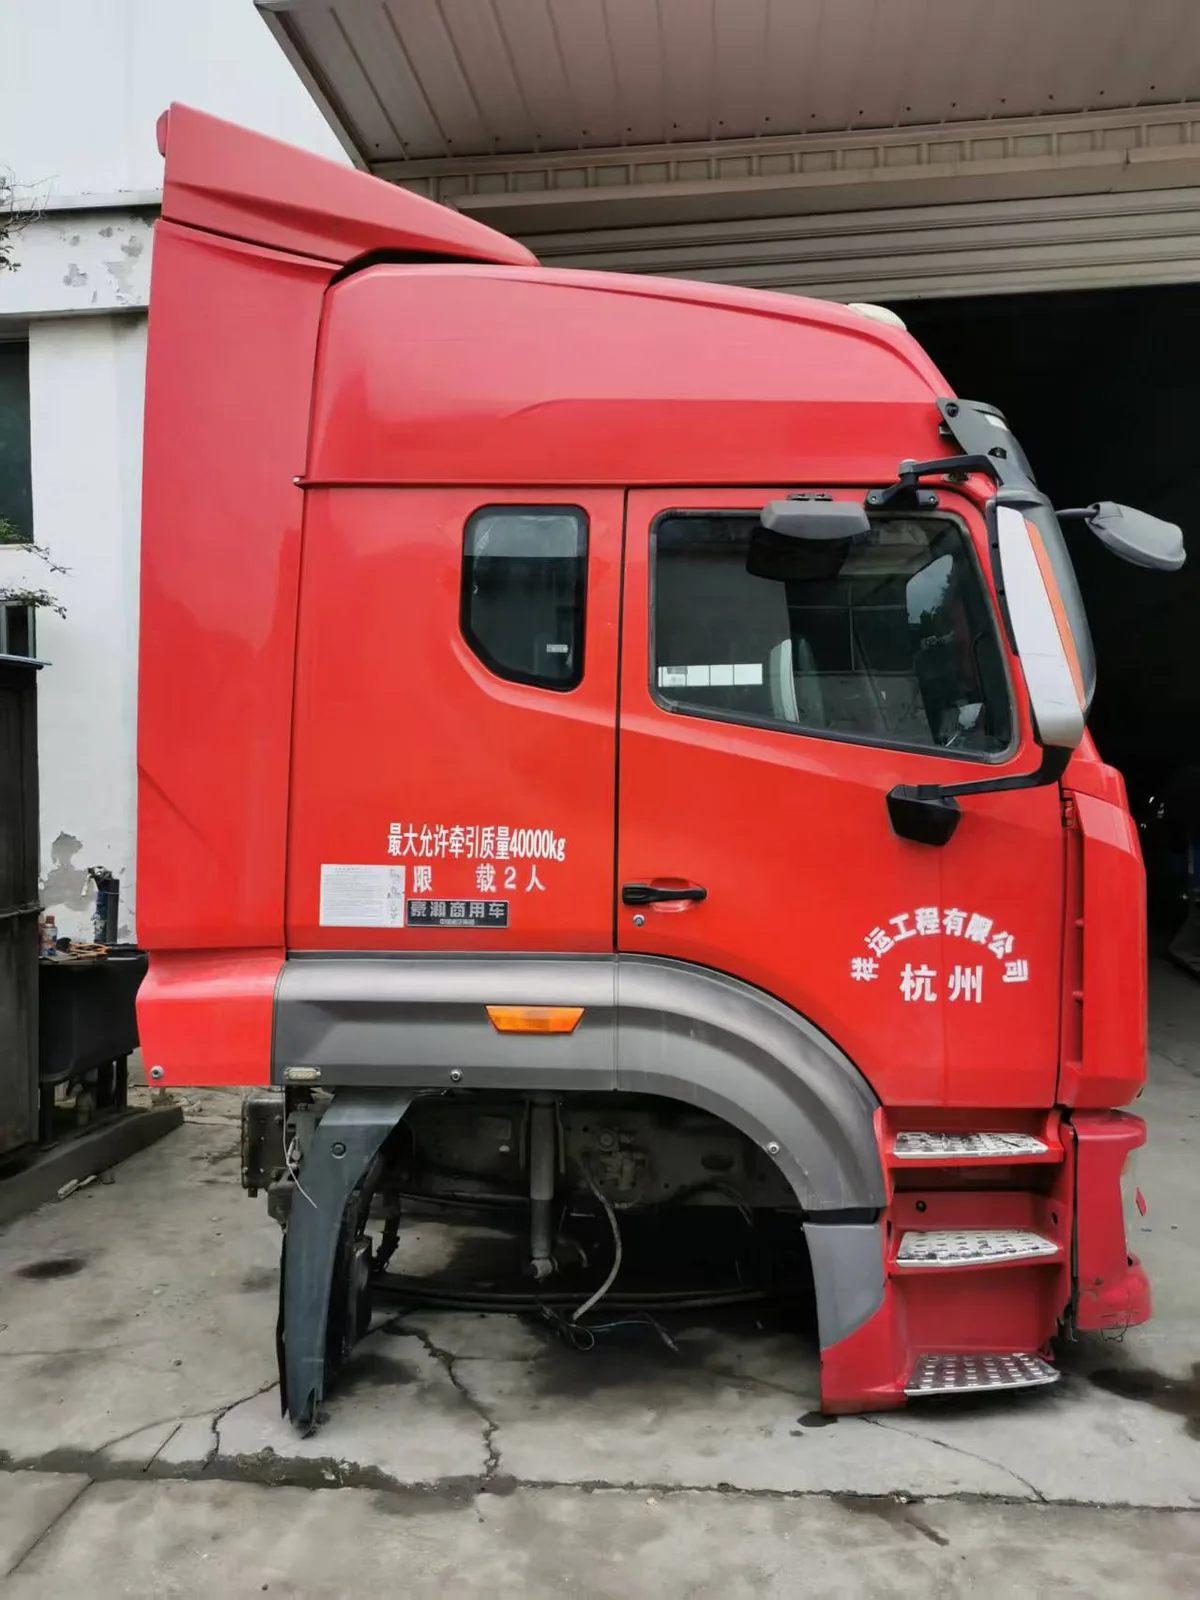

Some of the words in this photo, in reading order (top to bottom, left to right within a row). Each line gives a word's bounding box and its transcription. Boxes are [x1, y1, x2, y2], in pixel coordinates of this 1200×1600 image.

[387, 822, 566, 862] 最大允许牵引质量40000kg
[899, 963, 983, 1004] 杭州
